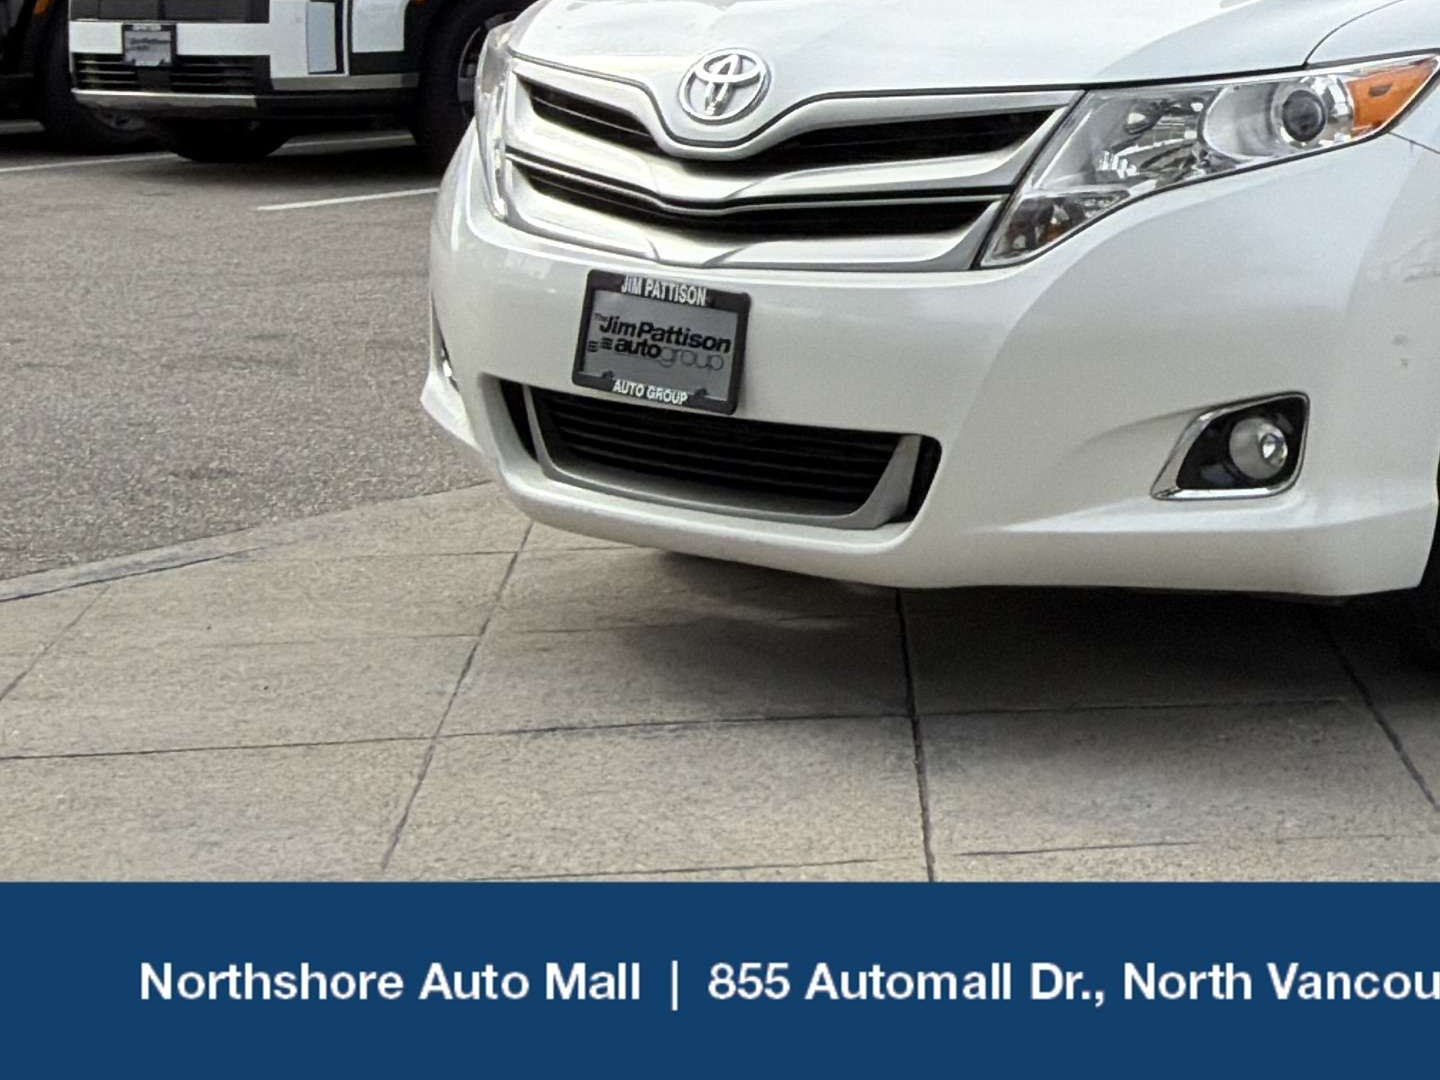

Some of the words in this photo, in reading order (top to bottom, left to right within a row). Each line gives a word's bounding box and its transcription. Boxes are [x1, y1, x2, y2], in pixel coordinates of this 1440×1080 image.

[621, 275, 643, 294] JIM
[644, 278, 707, 306] PATTISON
[612, 378, 644, 398] AUTO
[645, 385, 688, 405] GROUP
